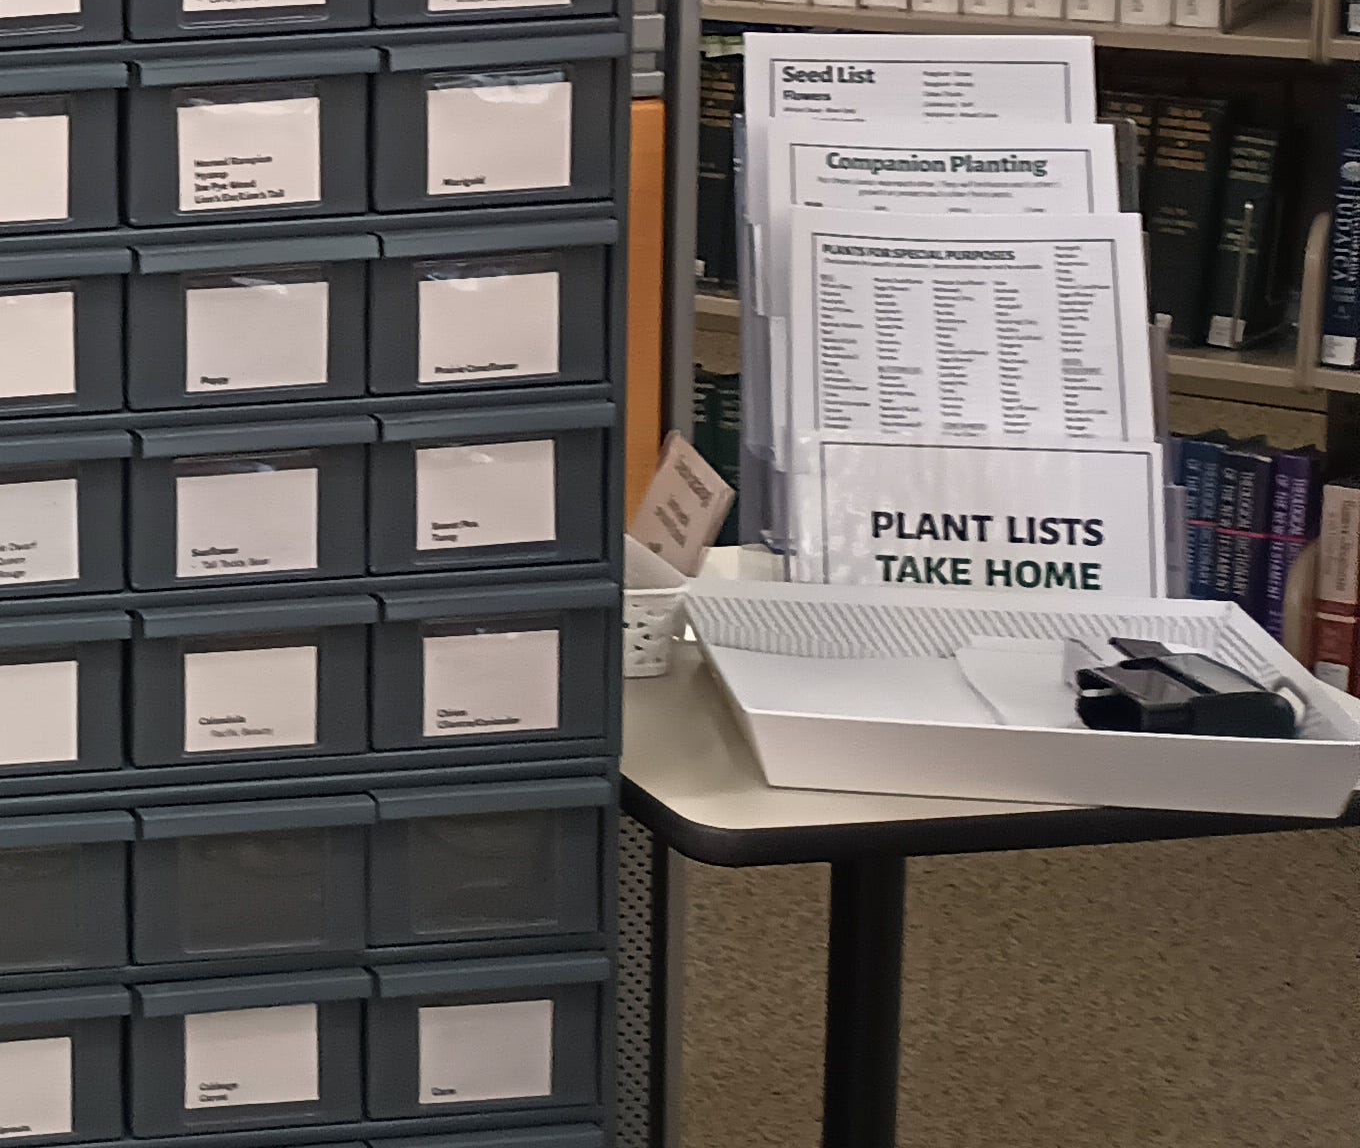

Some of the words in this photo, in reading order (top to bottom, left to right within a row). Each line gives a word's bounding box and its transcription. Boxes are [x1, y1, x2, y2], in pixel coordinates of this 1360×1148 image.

[782, 65, 833, 84] Seed
[837, 65, 875, 84] List
[826, 152, 947, 177] Companion
[949, 153, 1049, 178] Planting
[870, 510, 994, 543] PLANT
[1006, 514, 1105, 547] LISTS
[875, 554, 973, 586] TAKE
[985, 558, 1104, 591] HOME
